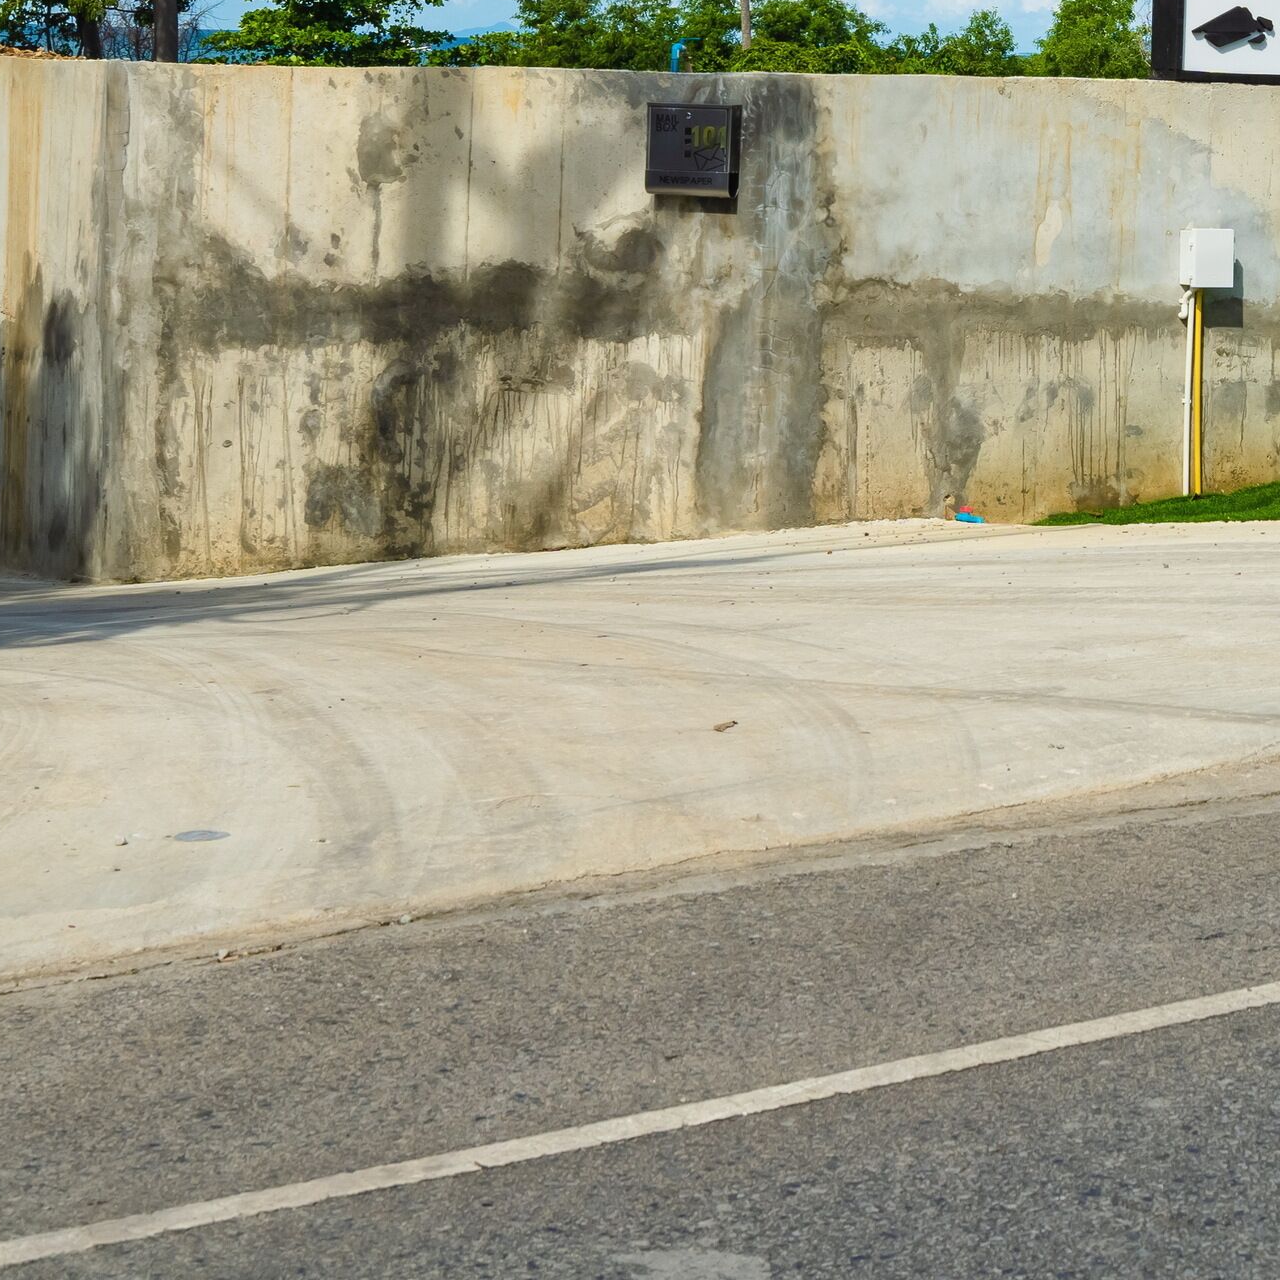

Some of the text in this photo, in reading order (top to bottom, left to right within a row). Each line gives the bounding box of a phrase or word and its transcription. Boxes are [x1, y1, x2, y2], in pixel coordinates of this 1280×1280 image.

[655, 113, 680, 124] MAIL
[655, 122, 678, 132] BOX
[691, 124, 727, 149] 101
[658, 175, 713, 185] NEWSPAPER
